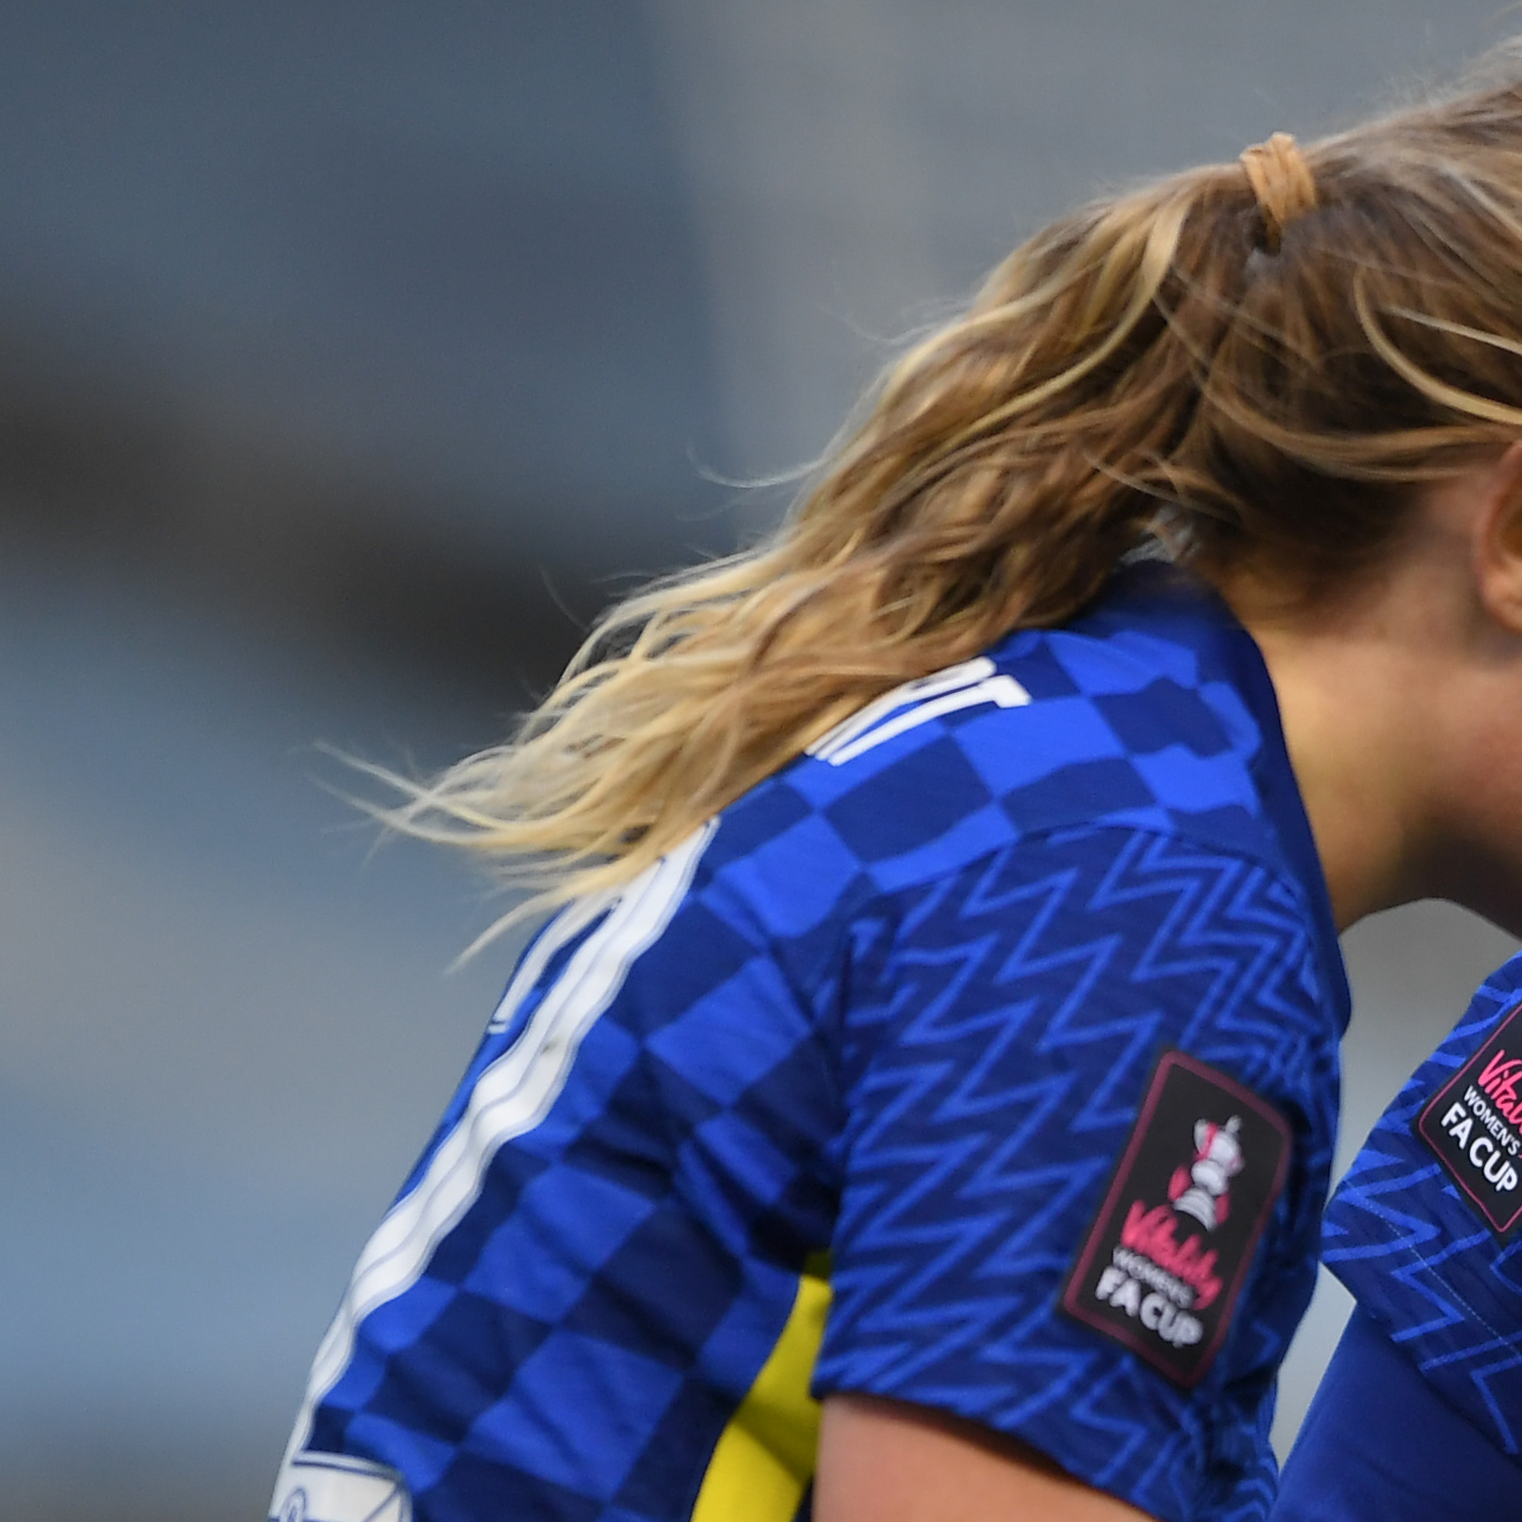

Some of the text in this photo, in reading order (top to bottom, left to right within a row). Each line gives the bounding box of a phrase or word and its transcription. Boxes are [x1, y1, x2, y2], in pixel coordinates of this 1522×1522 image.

[1441, 1102, 1519, 1191] FA CUP
[1464, 1085, 1521, 1156] WOMEN'S
[1095, 1266, 1203, 1347] FA CUP
